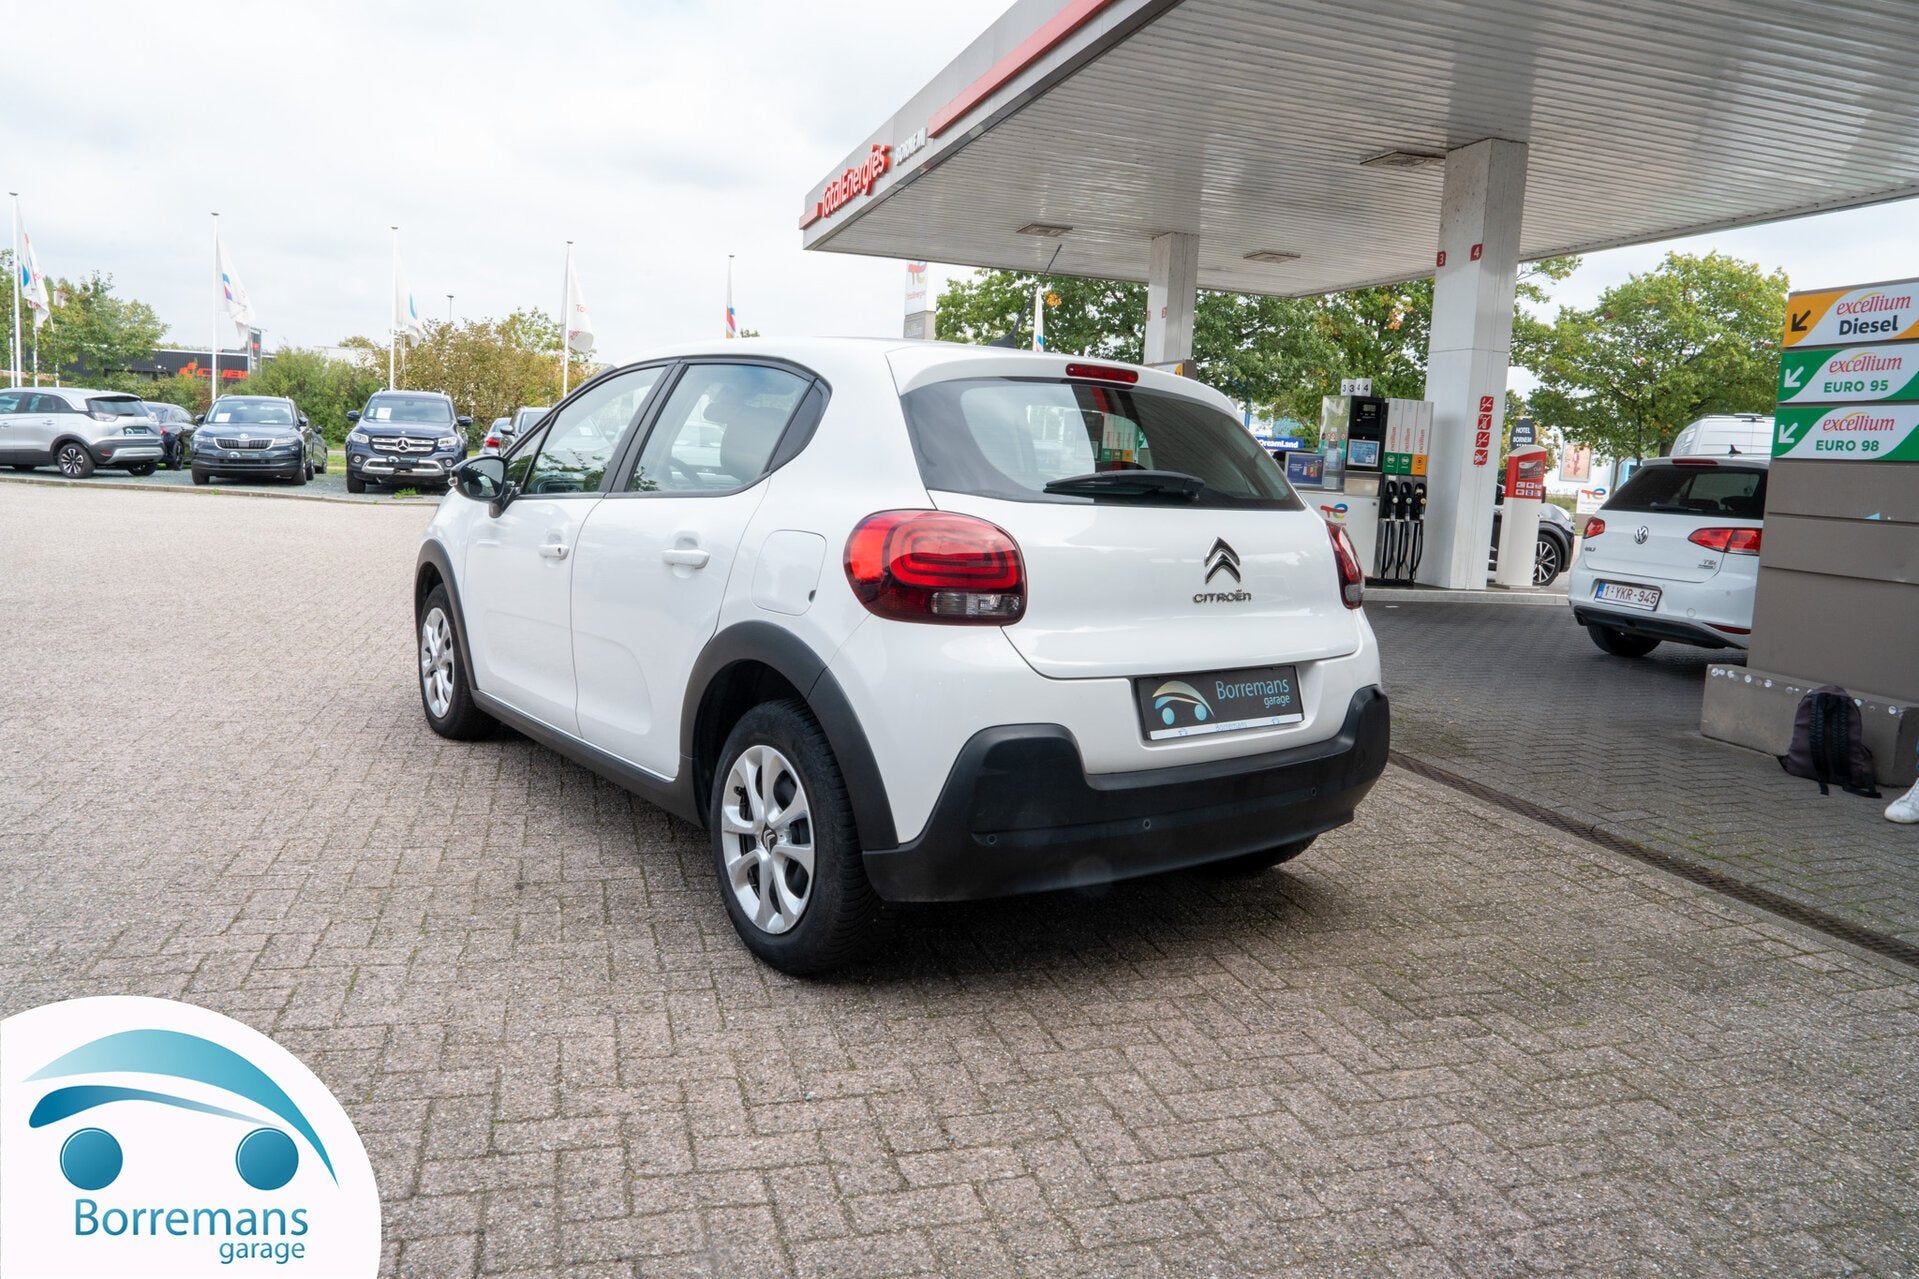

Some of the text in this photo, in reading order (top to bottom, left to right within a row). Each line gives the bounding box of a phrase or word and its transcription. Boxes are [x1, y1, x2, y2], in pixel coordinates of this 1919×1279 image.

[822, 145, 893, 216] TotalEnergies
[1836, 294, 1911, 316] excellium
[1839, 314, 1899, 336] Diesel
[1829, 353, 1903, 374] excellium
[1823, 380, 1889, 393] EURO 95
[1822, 414, 1896, 433] excellium
[1815, 440, 1880, 452] EURO 98
[1605, 585, 1658, 604] 1-YKR-945
[1215, 678, 1290, 701] Borremans
[1263, 694, 1291, 710] garage
